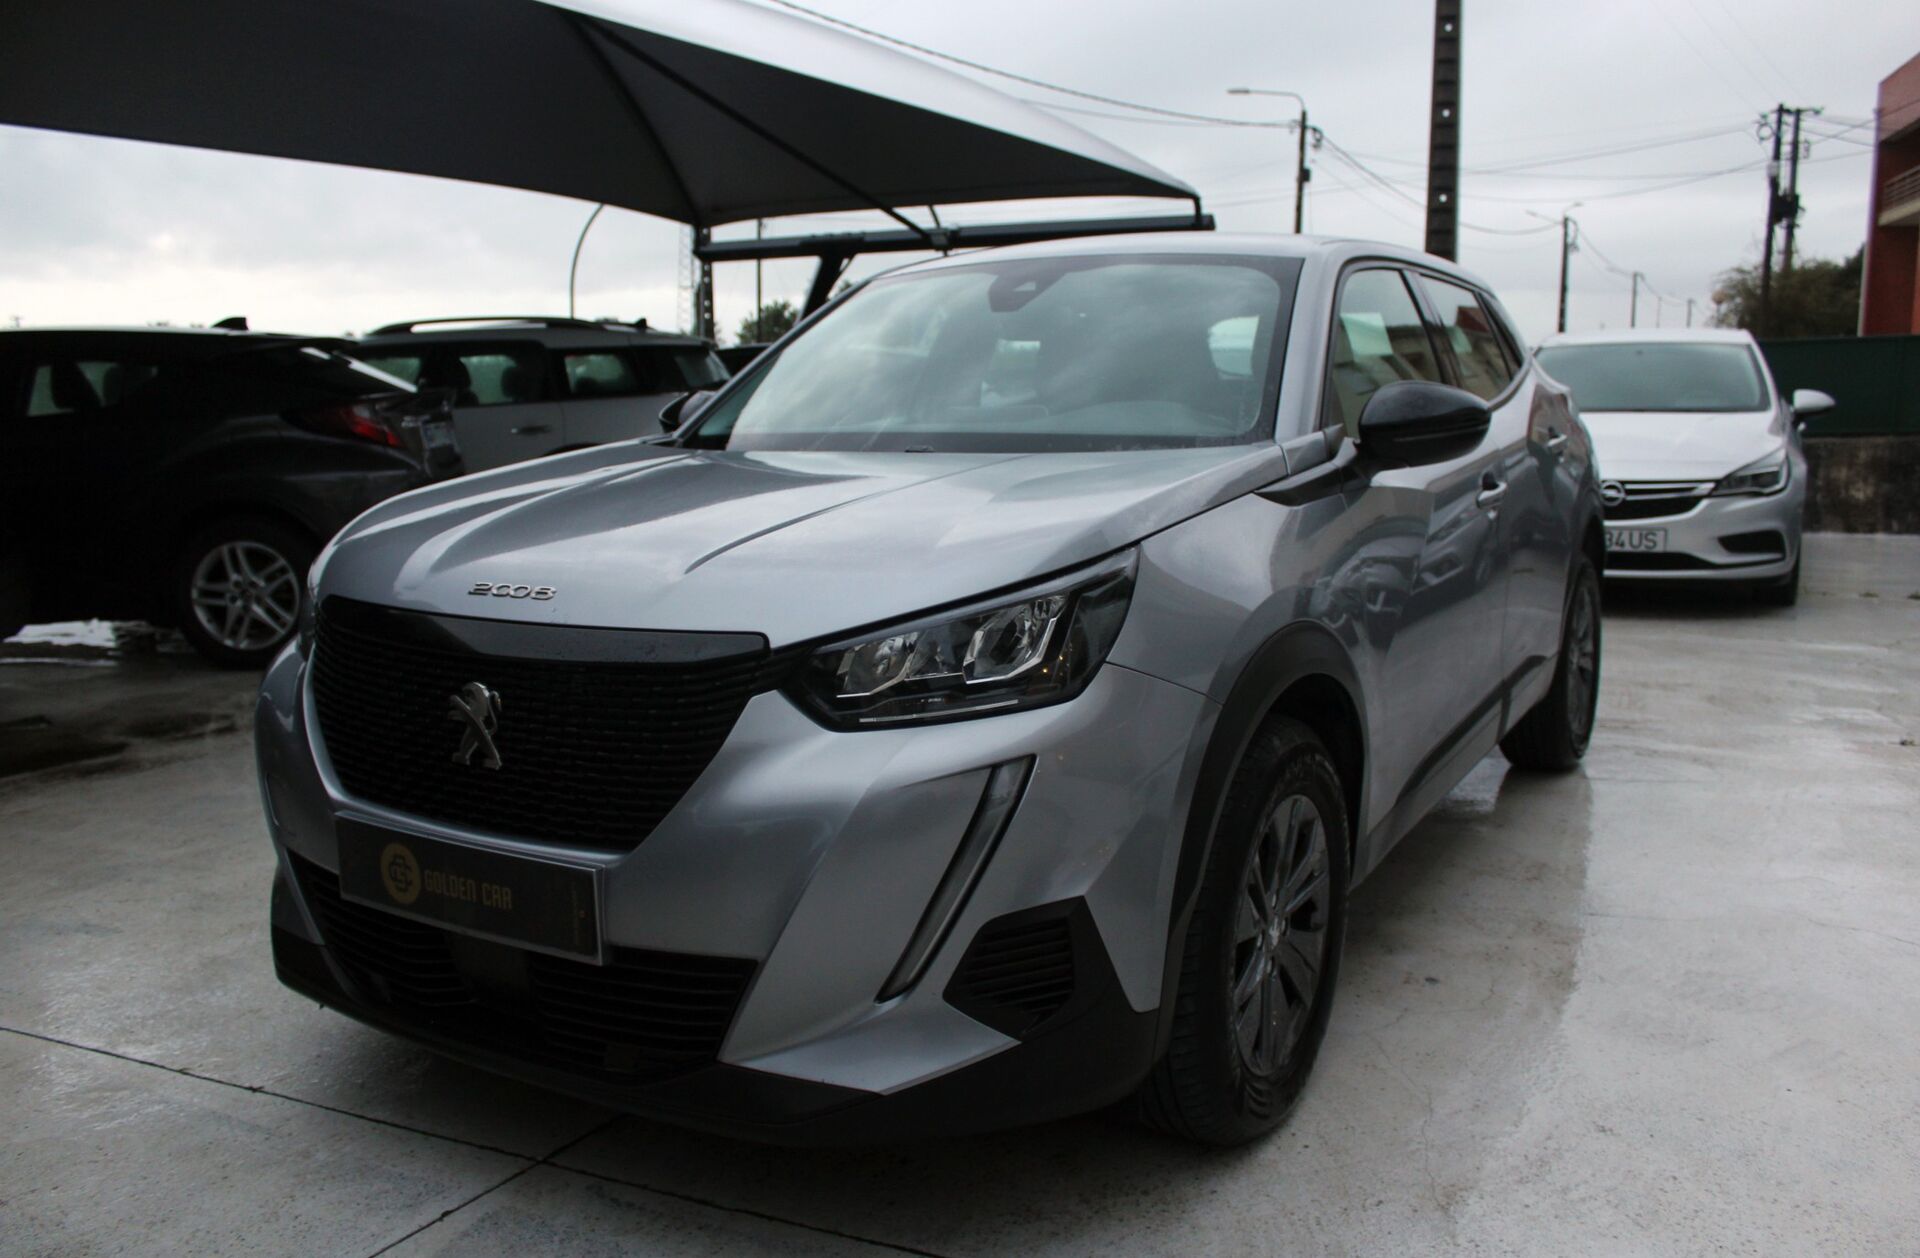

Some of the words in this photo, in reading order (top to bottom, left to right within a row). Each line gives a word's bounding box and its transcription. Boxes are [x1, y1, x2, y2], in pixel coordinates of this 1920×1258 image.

[468, 581, 557, 601] 2008
[424, 869, 476, 904] GOLDEN
[481, 882, 513, 910] CAR
